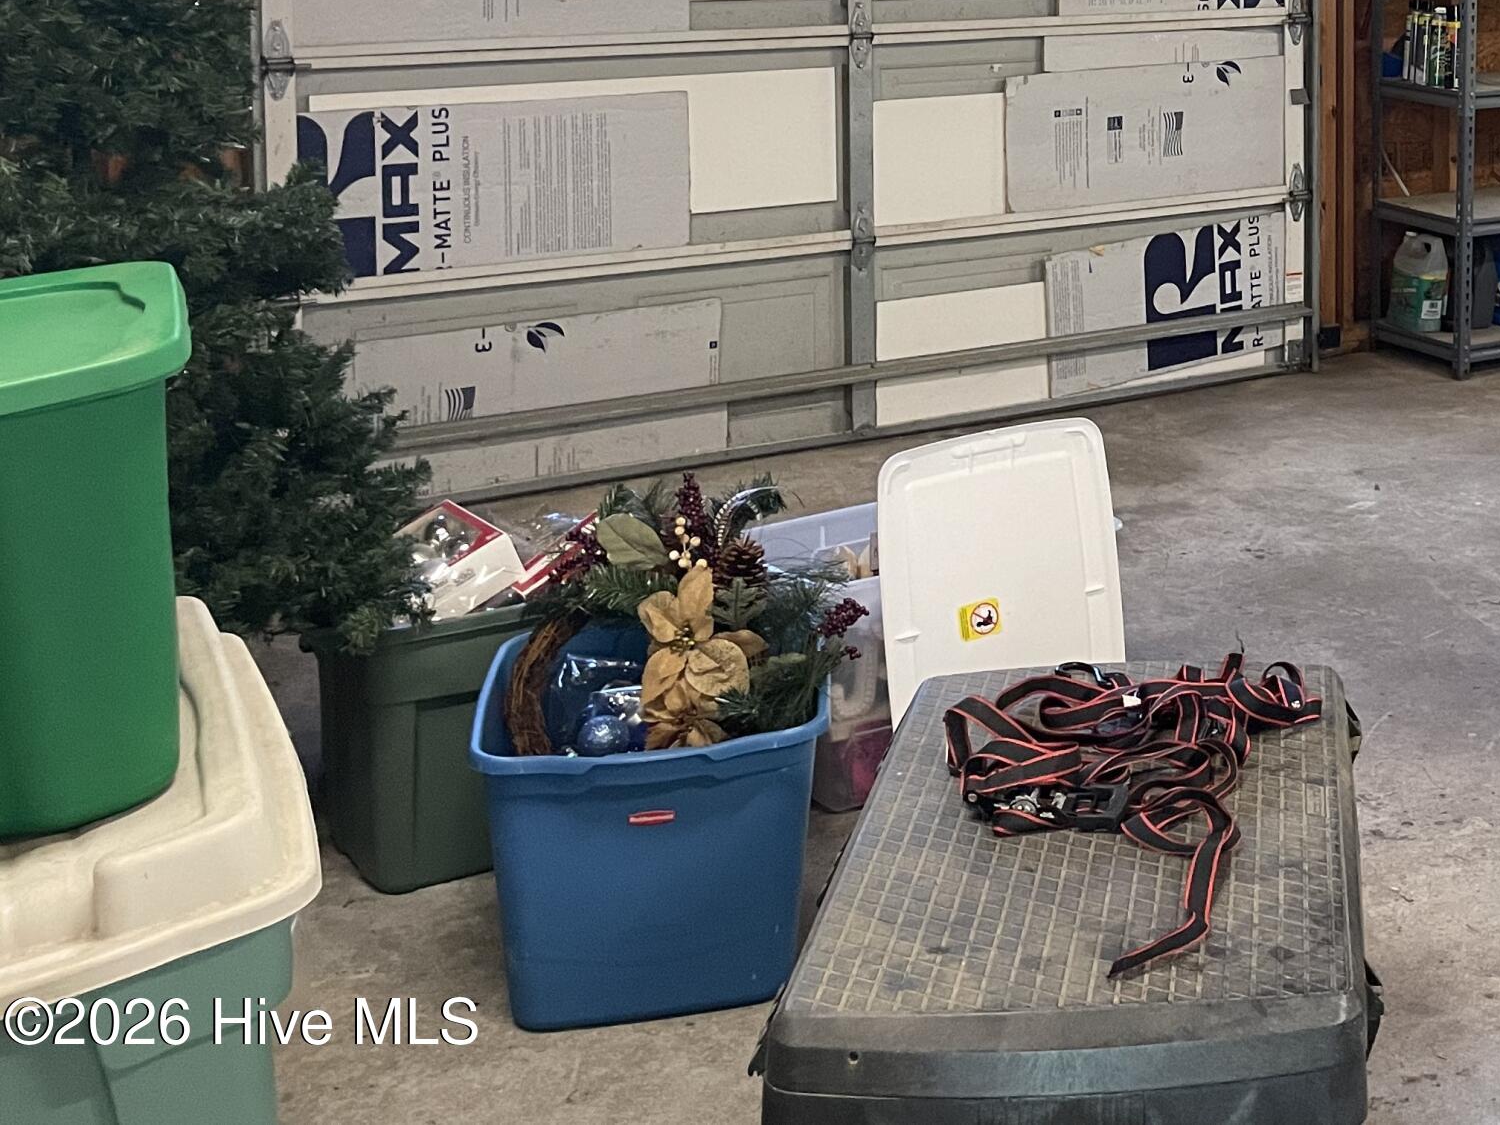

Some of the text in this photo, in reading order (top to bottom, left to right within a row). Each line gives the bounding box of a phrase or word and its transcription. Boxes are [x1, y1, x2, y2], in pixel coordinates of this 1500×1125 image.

[431, 107, 451, 162] PLUS
[381, 110, 420, 276] MAX
[1247, 215, 1261, 258] PLUS
